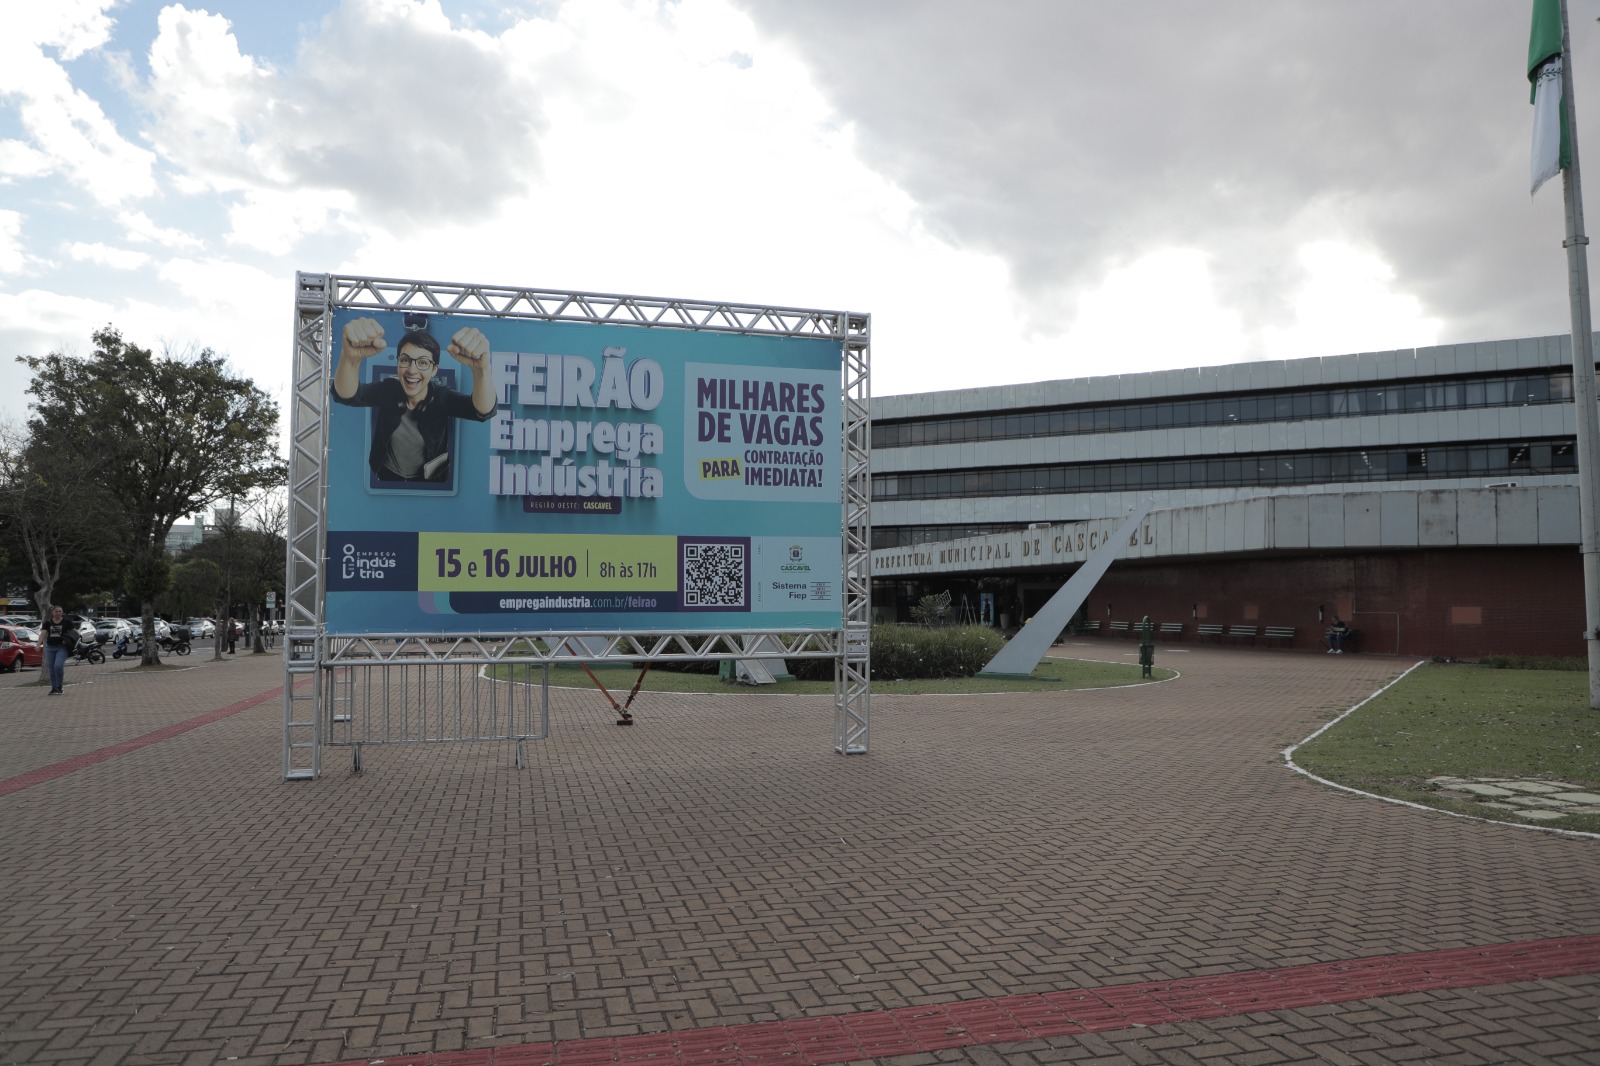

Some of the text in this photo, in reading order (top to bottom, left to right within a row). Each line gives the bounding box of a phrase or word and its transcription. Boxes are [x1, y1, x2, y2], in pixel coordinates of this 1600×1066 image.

[491, 345, 664, 411] FEIRÃO
[697, 377, 825, 414] MILHARES
[489, 409, 664, 460] Emprega
[697, 411, 825, 447] DE VAGAS
[744, 449, 824, 467] CONTRATAÇÃO
[489, 453, 664, 498] Indústria
[702, 459, 741, 478] PARA
[744, 467, 824, 488] IMEDIATA!
[530, 501, 555, 509] REGIÃO
[583, 501, 612, 510] CASCAVEL
[875, 524, 1153, 569] PREFEITURA MUNICIPAL DE CASCAEL
[356, 556, 396, 570] indús
[435, 548, 577, 578] 15 e 16 JULHO
[600, 561, 657, 578] 8h às 17h
[360, 568, 385, 579] tria
[772, 581, 807, 590] Sistema
[499, 595, 657, 611] empregaindustria.com.br/feirao
[788, 591, 807, 601] Fiep
